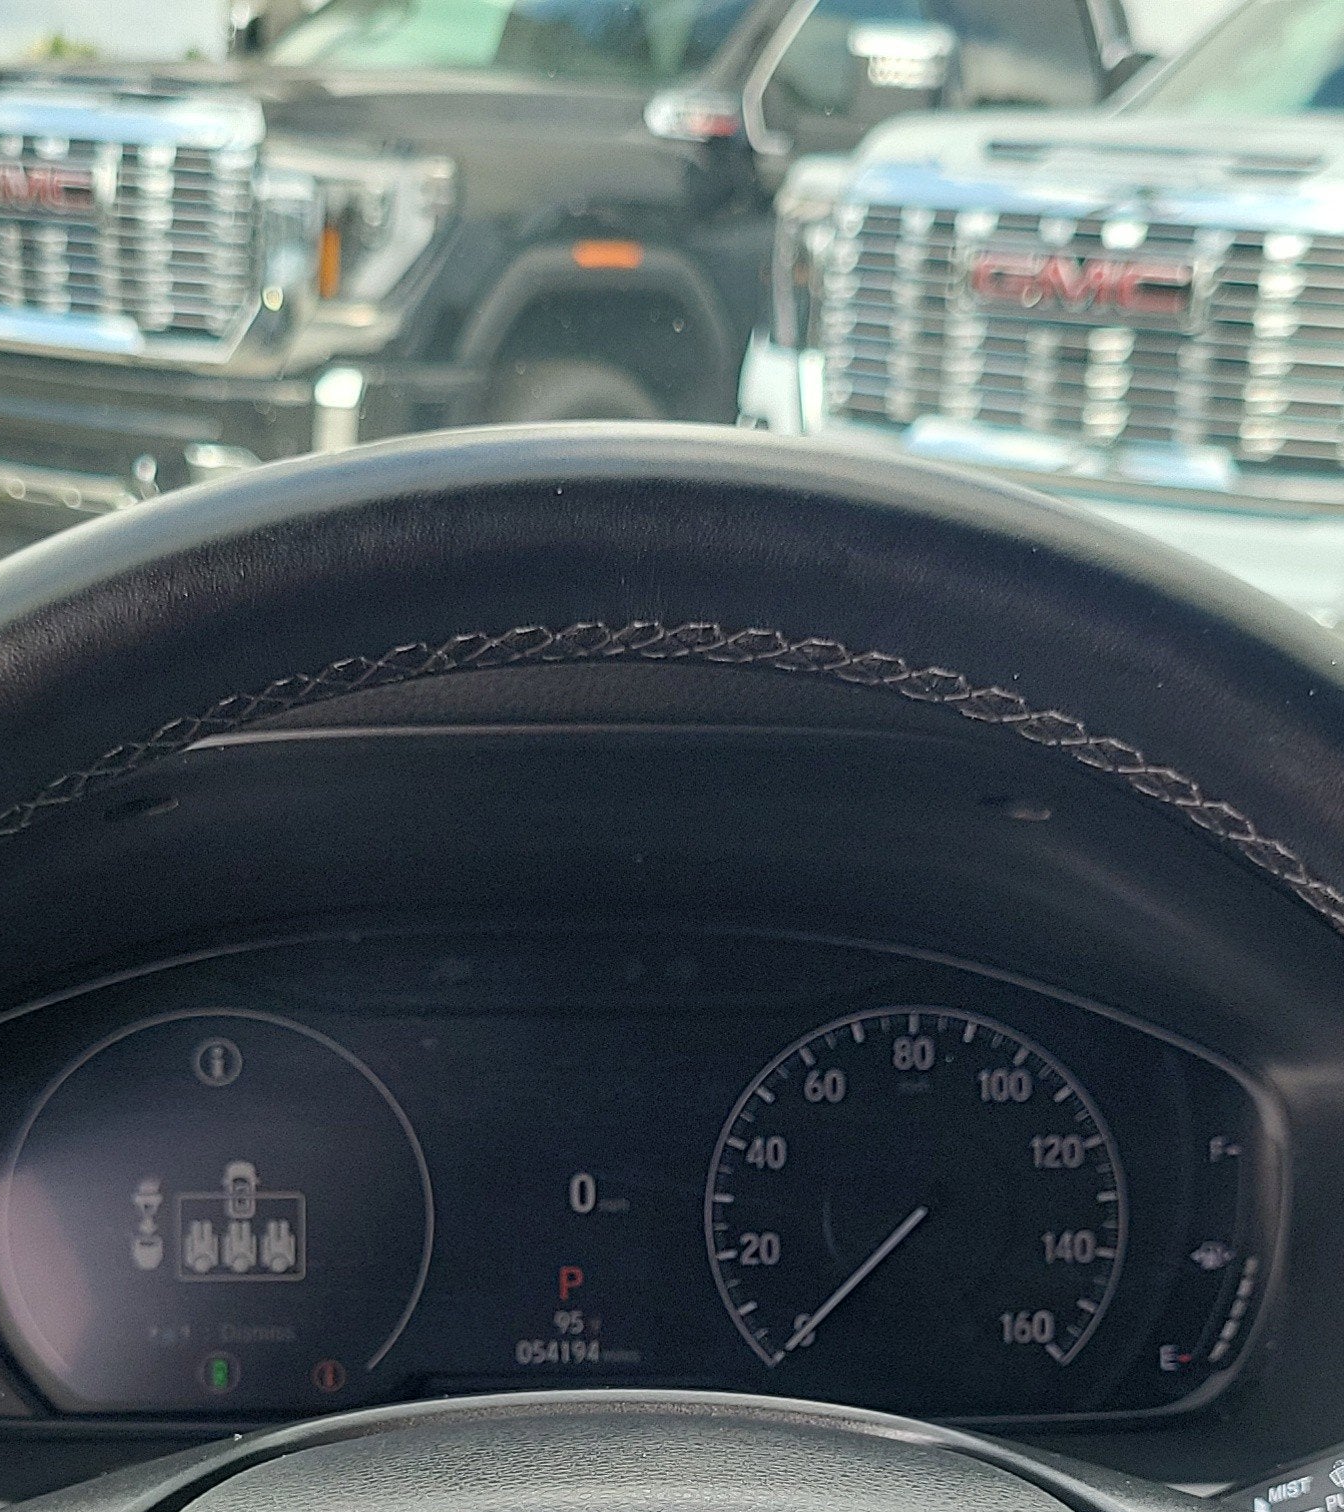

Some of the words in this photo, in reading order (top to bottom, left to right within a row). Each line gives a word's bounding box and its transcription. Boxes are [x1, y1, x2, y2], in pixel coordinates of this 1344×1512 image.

[971, 252, 1192, 314] GMC
[892, 1035, 935, 1071] 80
[804, 1068, 846, 1103] 60
[978, 1068, 1033, 1103] 100
[745, 1135, 787, 1170] 40
[1031, 1134, 1084, 1169] 120
[569, 1173, 597, 1214] 0
[739, 1232, 781, 1266] 20
[1042, 1229, 1096, 1264] 140
[560, 1266, 584, 1300] P
[554, 1310, 585, 1335] 95
[1000, 1309, 1055, 1344] 160
[515, 1339, 601, 1364] 054194
[1159, 1344, 1178, 1372] E
[1268, 1475, 1314, 1504] MIST
